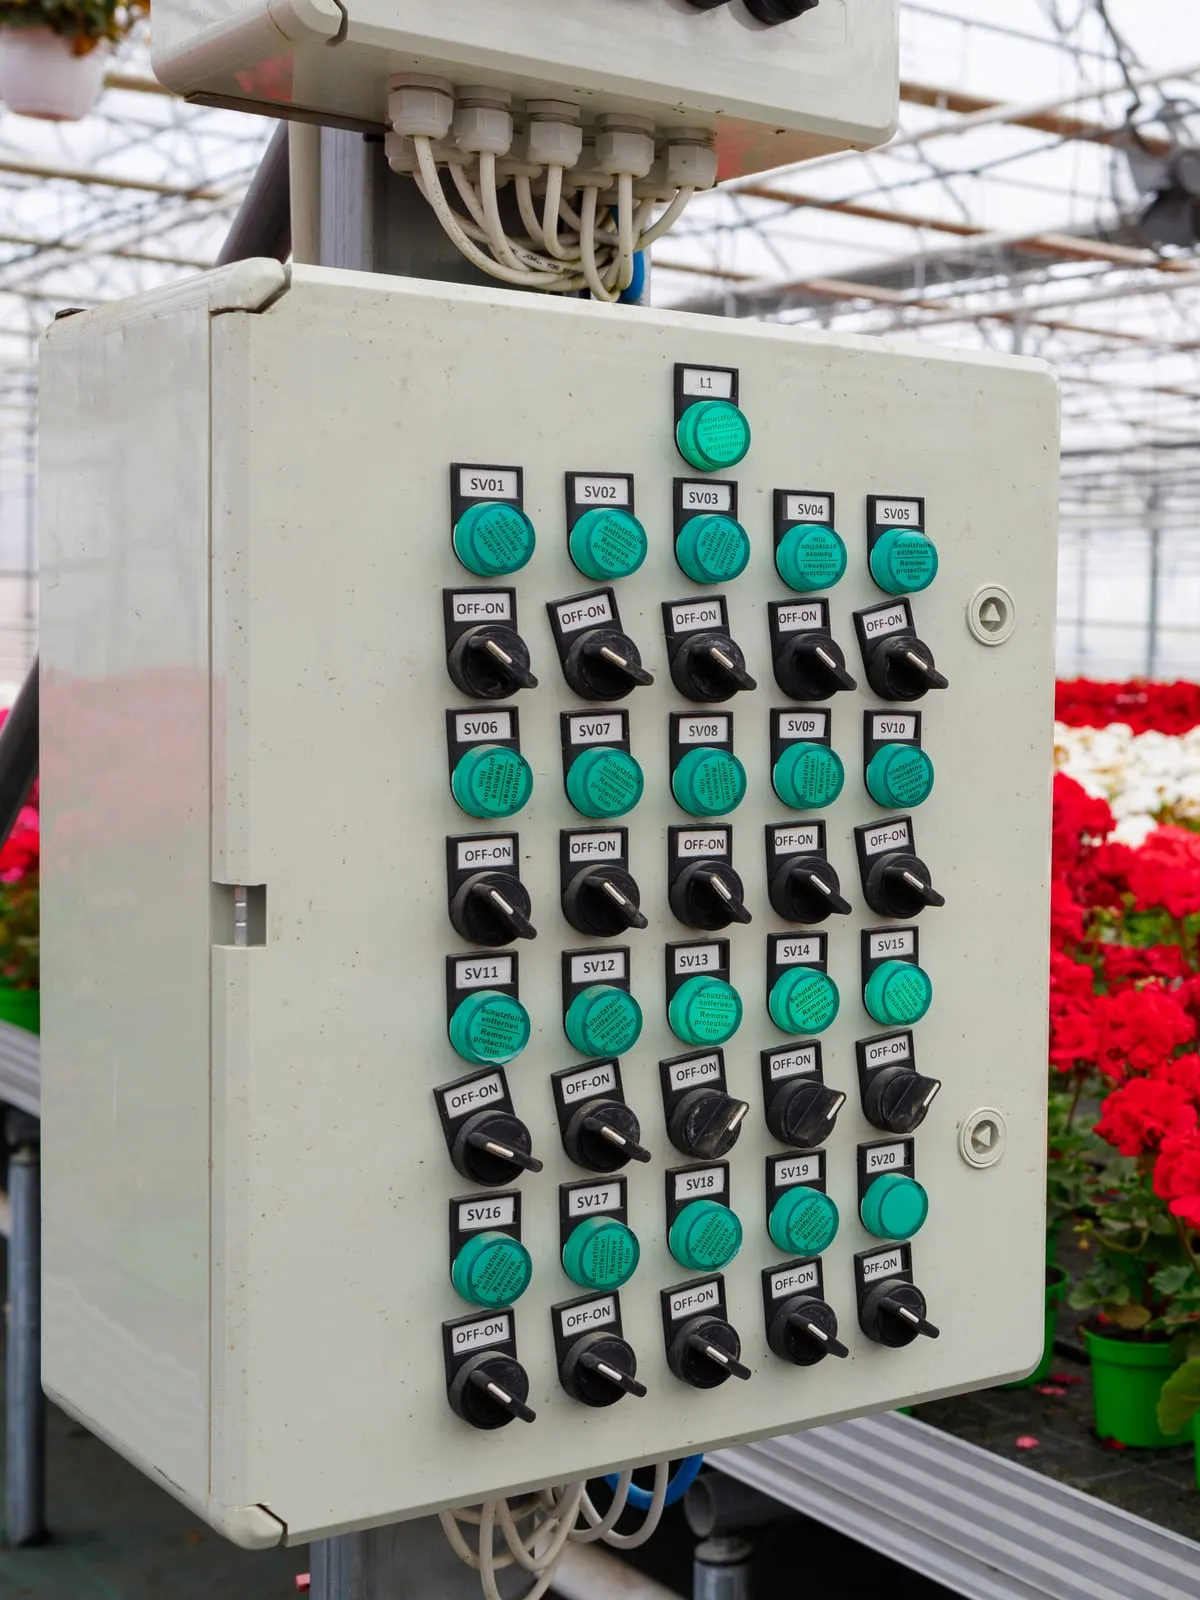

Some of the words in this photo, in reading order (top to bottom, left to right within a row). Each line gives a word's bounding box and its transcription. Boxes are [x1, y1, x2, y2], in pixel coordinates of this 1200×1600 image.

[700, 376, 713, 389] L1
[470, 477, 505, 492] SV01
[584, 485, 617, 499] SV02
[688, 491, 719, 505] SV03
[797, 503, 824, 516] SV04
[883, 507, 910, 521] SV05
[456, 602, 505, 615] OFF-ON
[561, 603, 606, 625] OFF-ON
[675, 609, 717, 625] OFF-ON
[779, 610, 817, 624] OFF-ON
[866, 613, 903, 632] OFF-ON
[463, 720, 498, 736] SV06
[578, 722, 611, 738] SV07
[688, 724, 719, 737] SV08
[787, 719, 816, 733] SV09
[880, 721, 906, 734] SV10
[683, 838, 725, 851] OFF-ON
[775, 834, 814, 847] OFF-ON
[870, 828, 907, 847] OFF-ON
[464, 846, 511, 862] OFF-ON
[571, 840, 616, 855] OFF-ON
[783, 944, 811, 958] SV14
[877, 937, 905, 952] SV15
[583, 959, 616, 974] SV12
[679, 953, 709, 968] SV13
[464, 965, 499, 981] SV11
[869, 1040, 907, 1060] OFF-ON
[772, 1053, 811, 1071] OFF-ON
[675, 1061, 717, 1082] OFF-ON
[565, 1072, 611, 1095] OFF-ON
[451, 1082, 499, 1109] OFF-ON
[870, 1152, 896, 1167] SV20
[780, 1164, 809, 1180] SV19
[686, 1175, 715, 1191] SV18
[577, 1191, 609, 1209] SV17
[466, 1206, 502, 1222] SV16
[863, 1257, 898, 1275] OFF-ON
[774, 1270, 814, 1291] OFF-ON
[673, 1289, 714, 1312] OFF-ON
[566, 1305, 611, 1328] OFF-ON
[456, 1321, 504, 1344] OFF-ON
